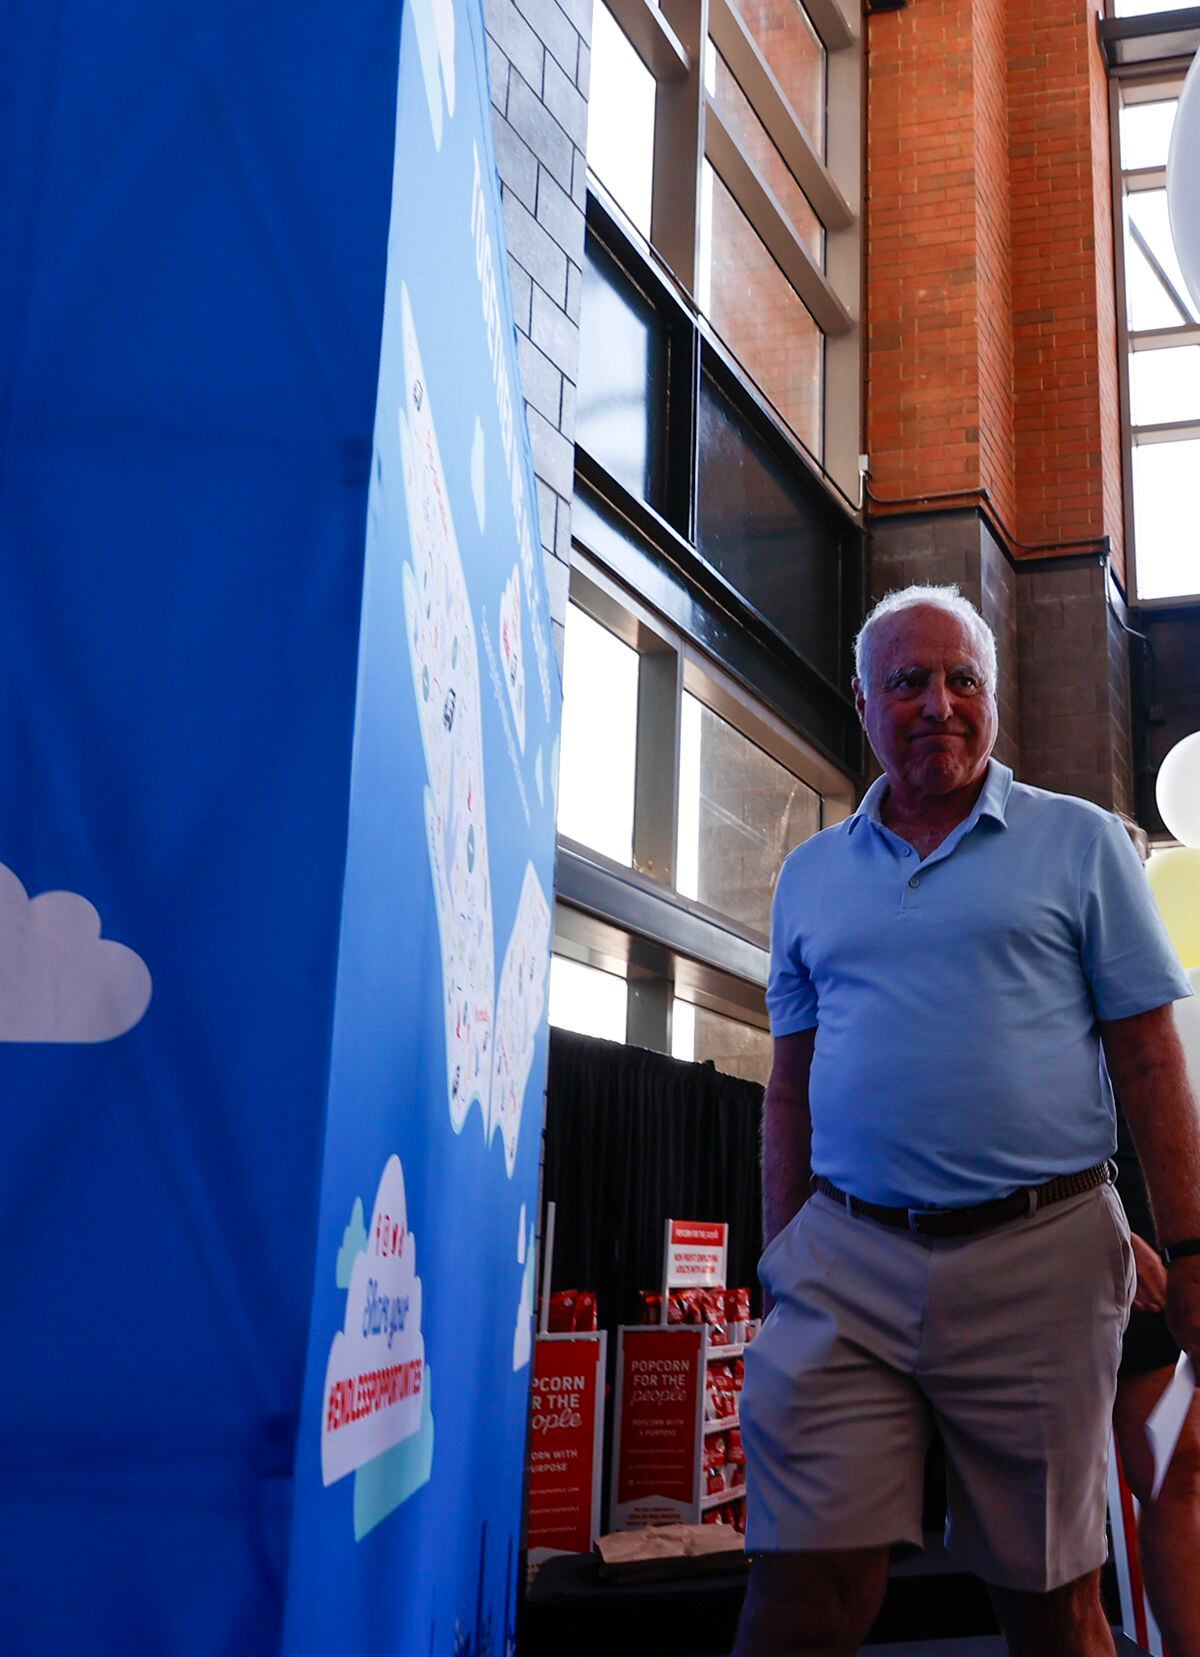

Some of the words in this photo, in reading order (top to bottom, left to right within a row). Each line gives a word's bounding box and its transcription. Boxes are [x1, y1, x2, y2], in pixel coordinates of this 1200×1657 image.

[631, 1360, 690, 1372] POPCORN
[532, 1376, 585, 1392] PCORN
[633, 1374, 658, 1387] FOR
[662, 1374, 686, 1387] THE
[546, 1393, 580, 1409] THE
[532, 1407, 583, 1435] ople
